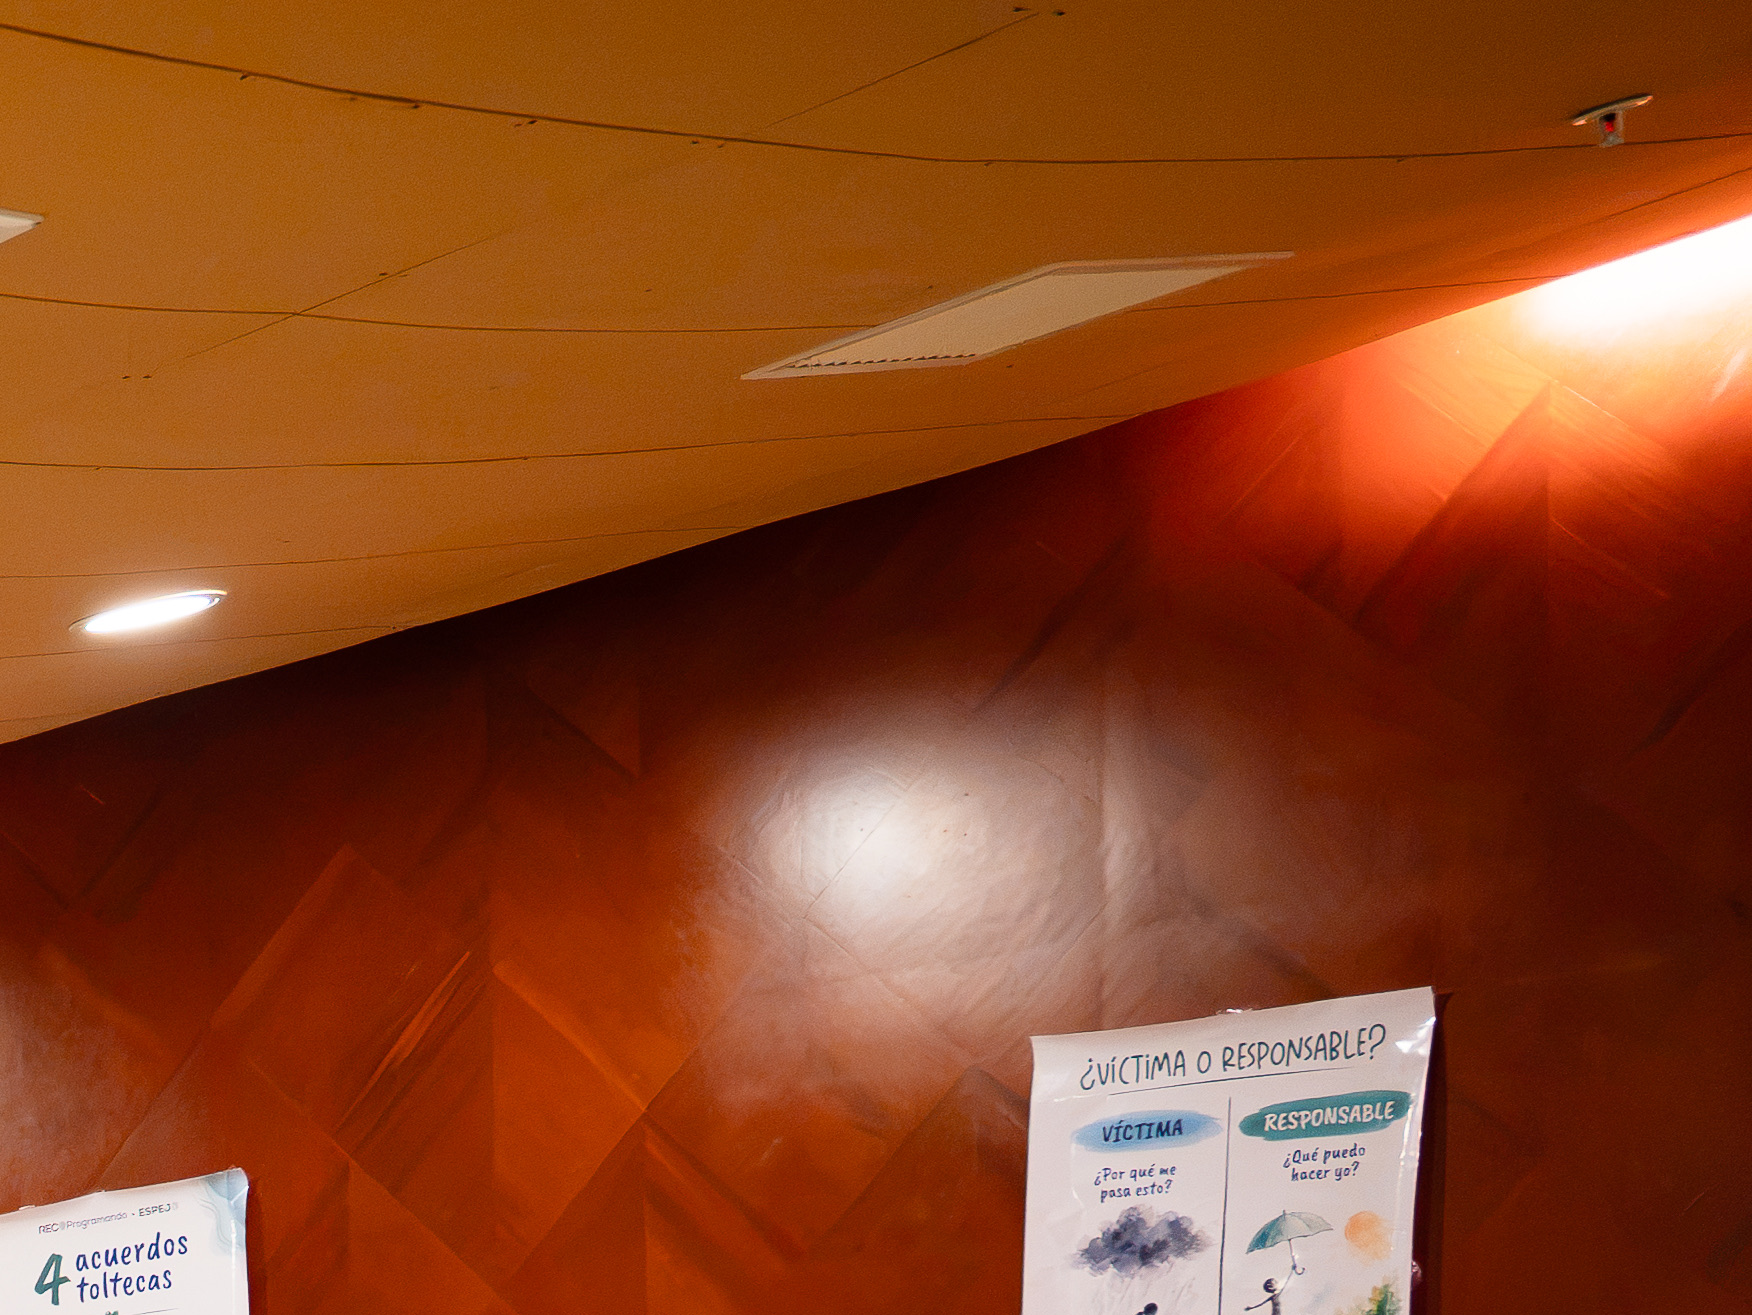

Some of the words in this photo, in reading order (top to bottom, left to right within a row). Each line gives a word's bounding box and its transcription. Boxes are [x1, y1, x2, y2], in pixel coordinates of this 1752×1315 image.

[1080, 1050, 1186, 1090] ¿VÍCTIMA
[1197, 1051, 1211, 1073] O
[1222, 1024, 1386, 1072] RESPONSABLE?
[1263, 1101, 1394, 1132] RESPONSABLE
[1102, 1119, 1183, 1143] VÍCTIMA
[1283, 1146, 1319, 1168] ¿Qué
[1322, 1143, 1366, 1166] puedo
[1094, 1167, 1125, 1186] ¿Por
[1130, 1164, 1156, 1182] qué
[1159, 1165, 1177, 1176] me
[1291, 1166, 1332, 1182] hacer
[1335, 1162, 1359, 1182] yo?
[1101, 1185, 1132, 1203] pasa
[1135, 1179, 1173, 1197] esto?
[34, 1253, 71, 1305] 4
[76, 1232, 187, 1271] acuerdos
[77, 1270, 172, 1303] toltecas
